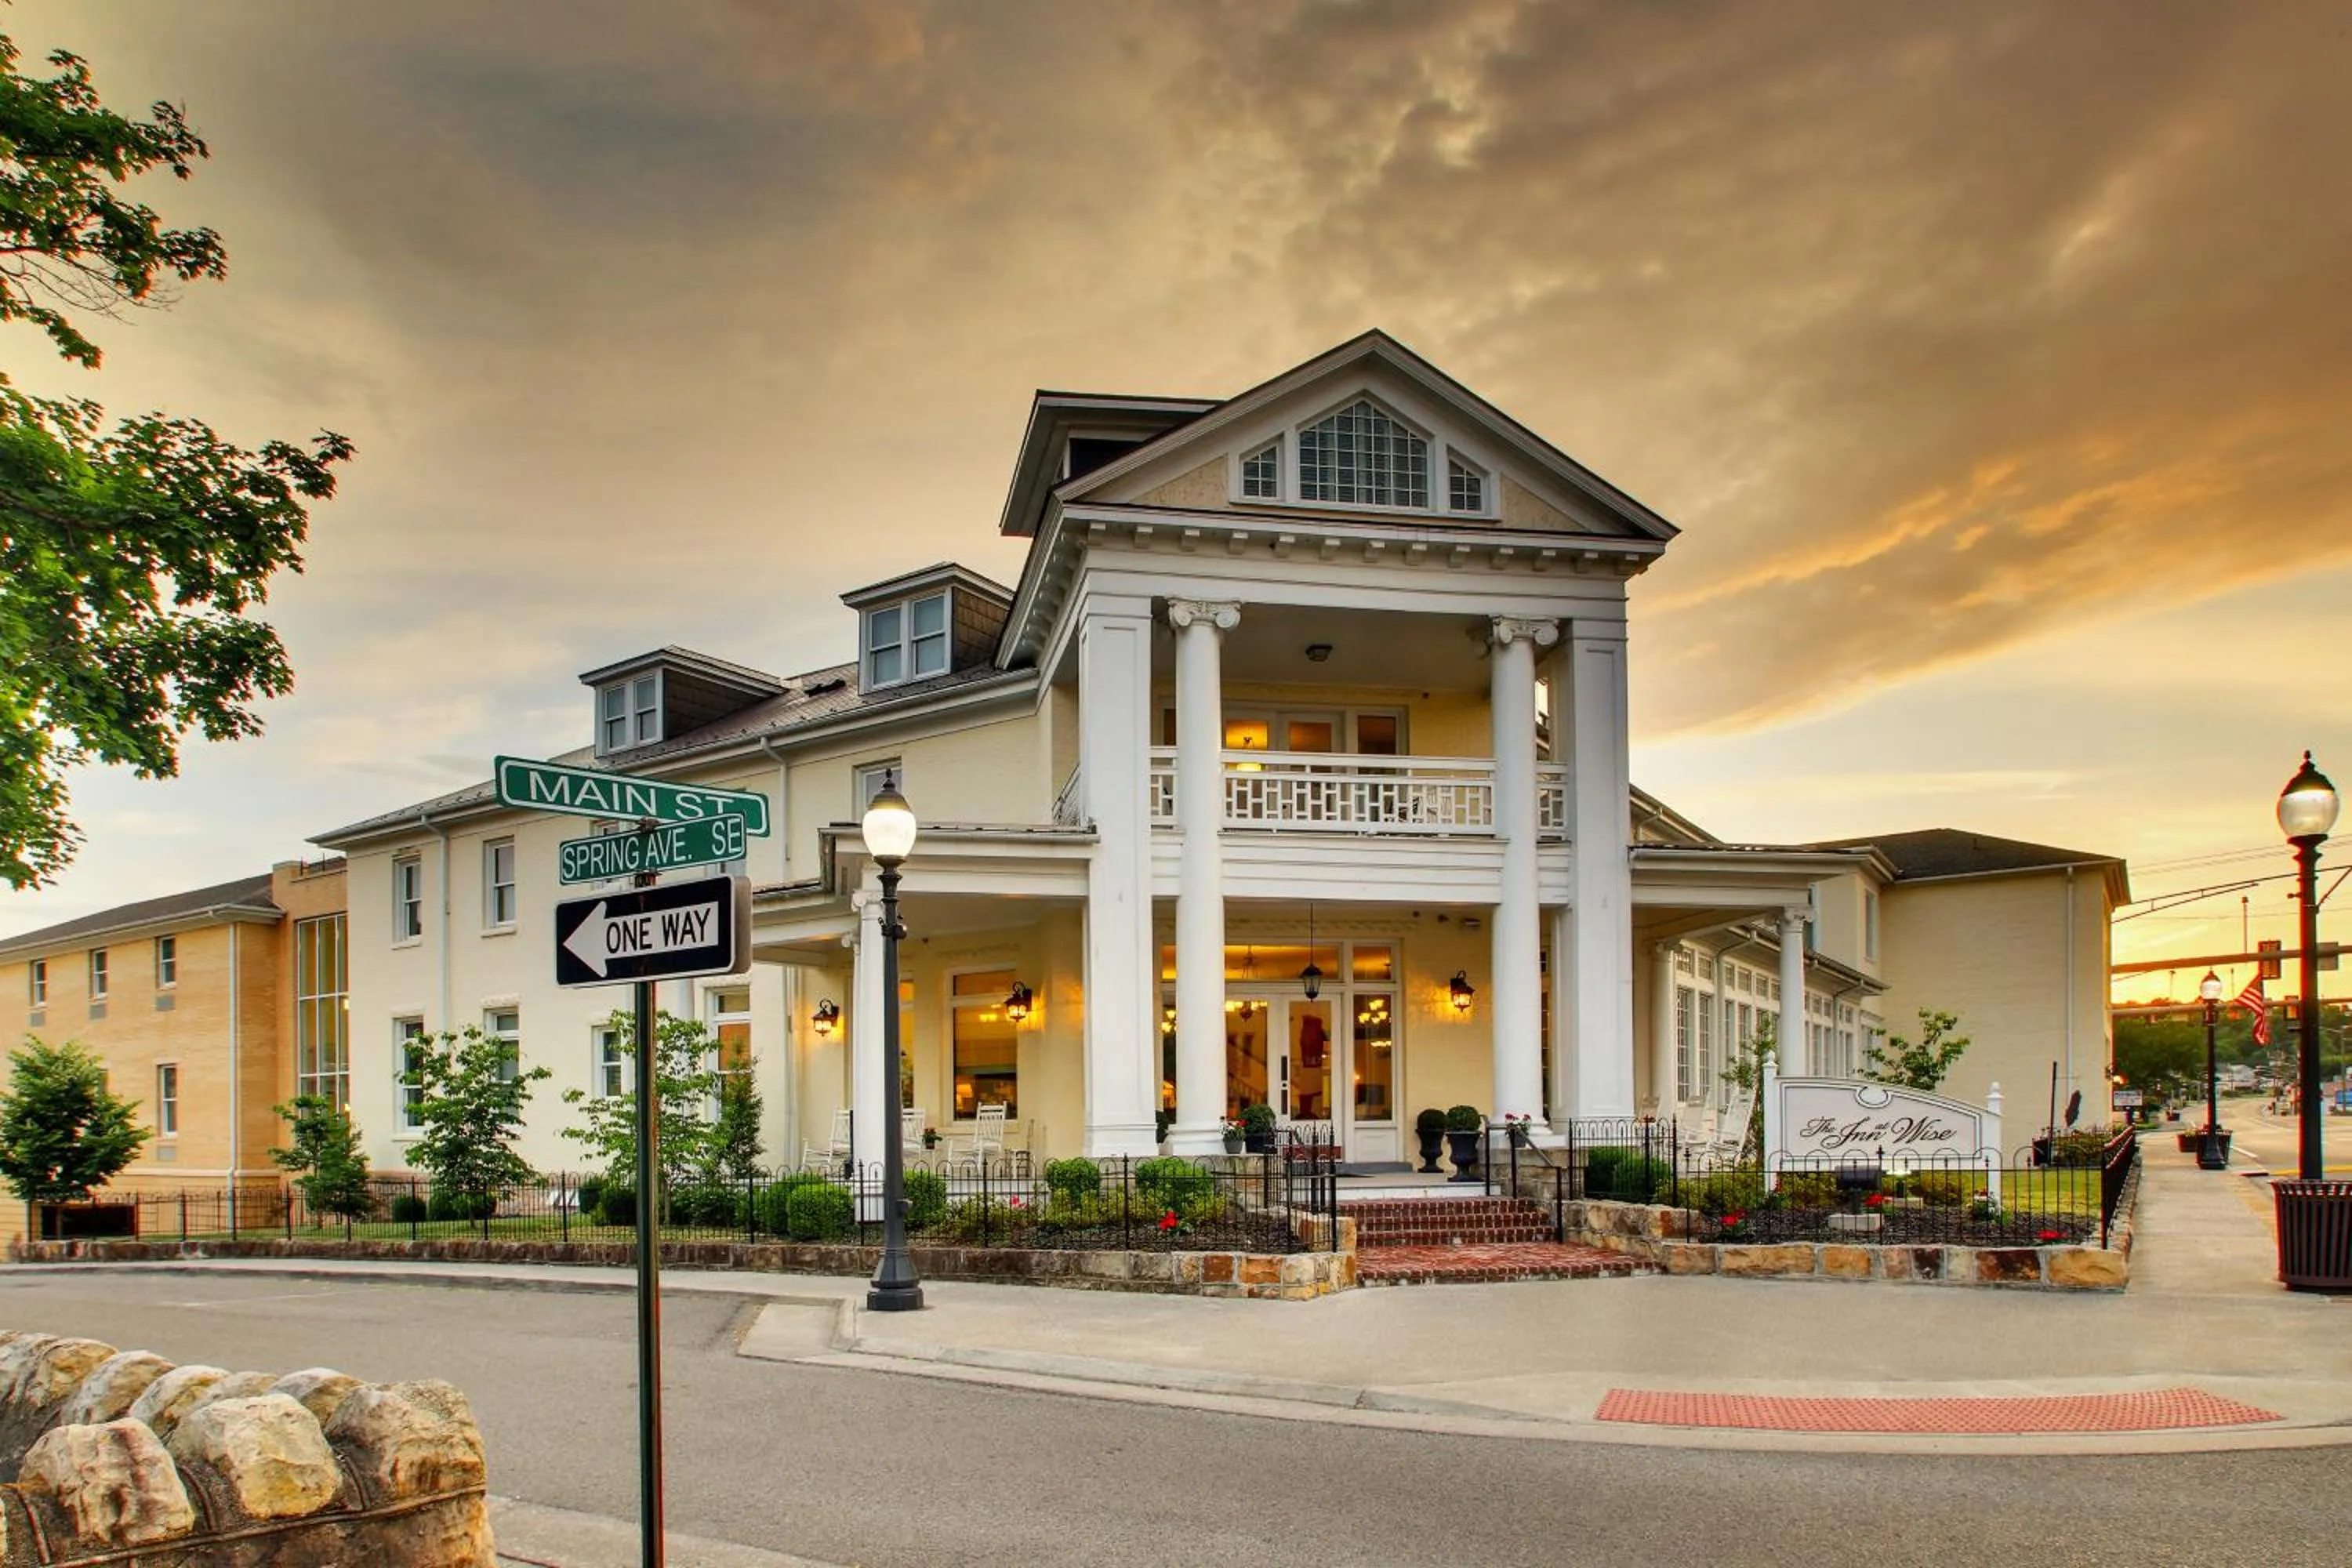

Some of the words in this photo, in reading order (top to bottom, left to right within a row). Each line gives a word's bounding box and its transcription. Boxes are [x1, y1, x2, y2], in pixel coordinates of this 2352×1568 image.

[529, 771, 656, 816] MAIN
[675, 793, 734, 820] ST
[562, 836, 640, 879] SPRING
[645, 827, 692, 866] AVE.
[712, 818, 742, 855] SE
[606, 917, 652, 954] ONE
[662, 907, 711, 946] WAY
[1800, 1116, 1835, 1137] The
[1820, 1116, 1887, 1149] Inn
[1891, 1116, 1957, 1144] Wise
